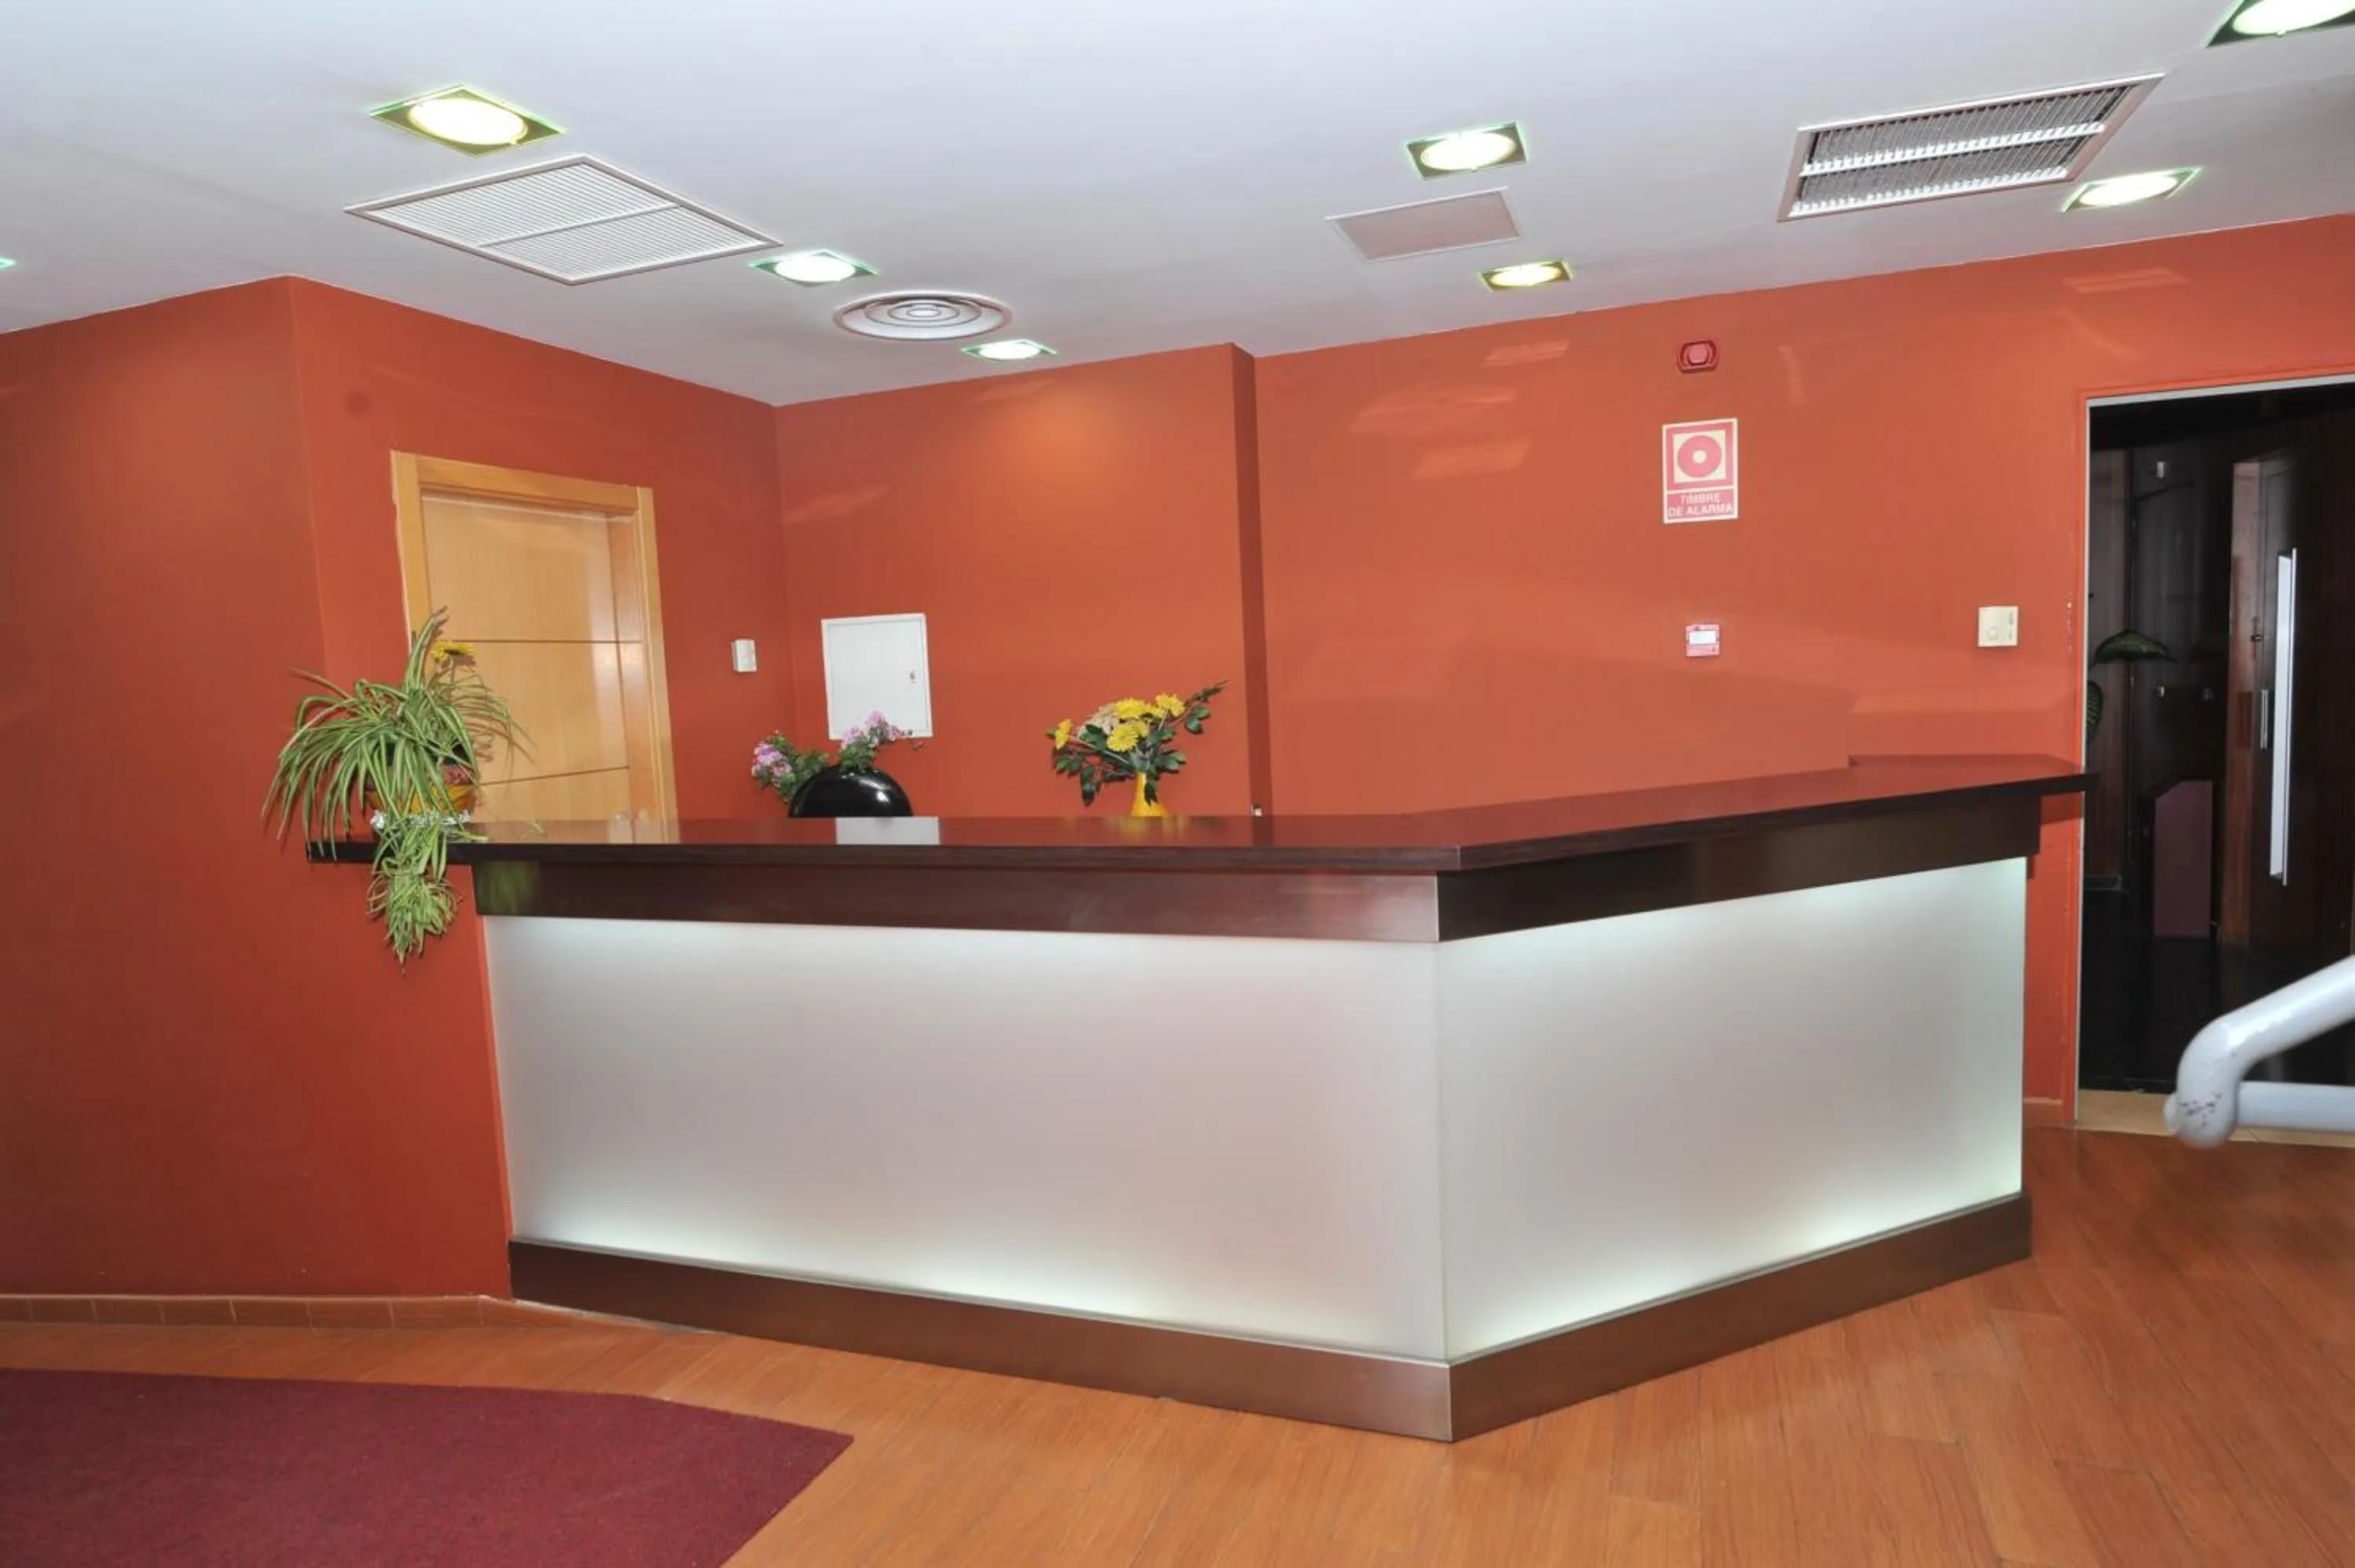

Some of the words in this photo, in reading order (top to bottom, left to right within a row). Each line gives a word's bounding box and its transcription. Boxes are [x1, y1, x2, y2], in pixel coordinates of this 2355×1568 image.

[1681, 492, 1722, 504] TIMBRE
[1669, 506, 1684, 516] DE
[1686, 502, 1733, 516] ALARMA
